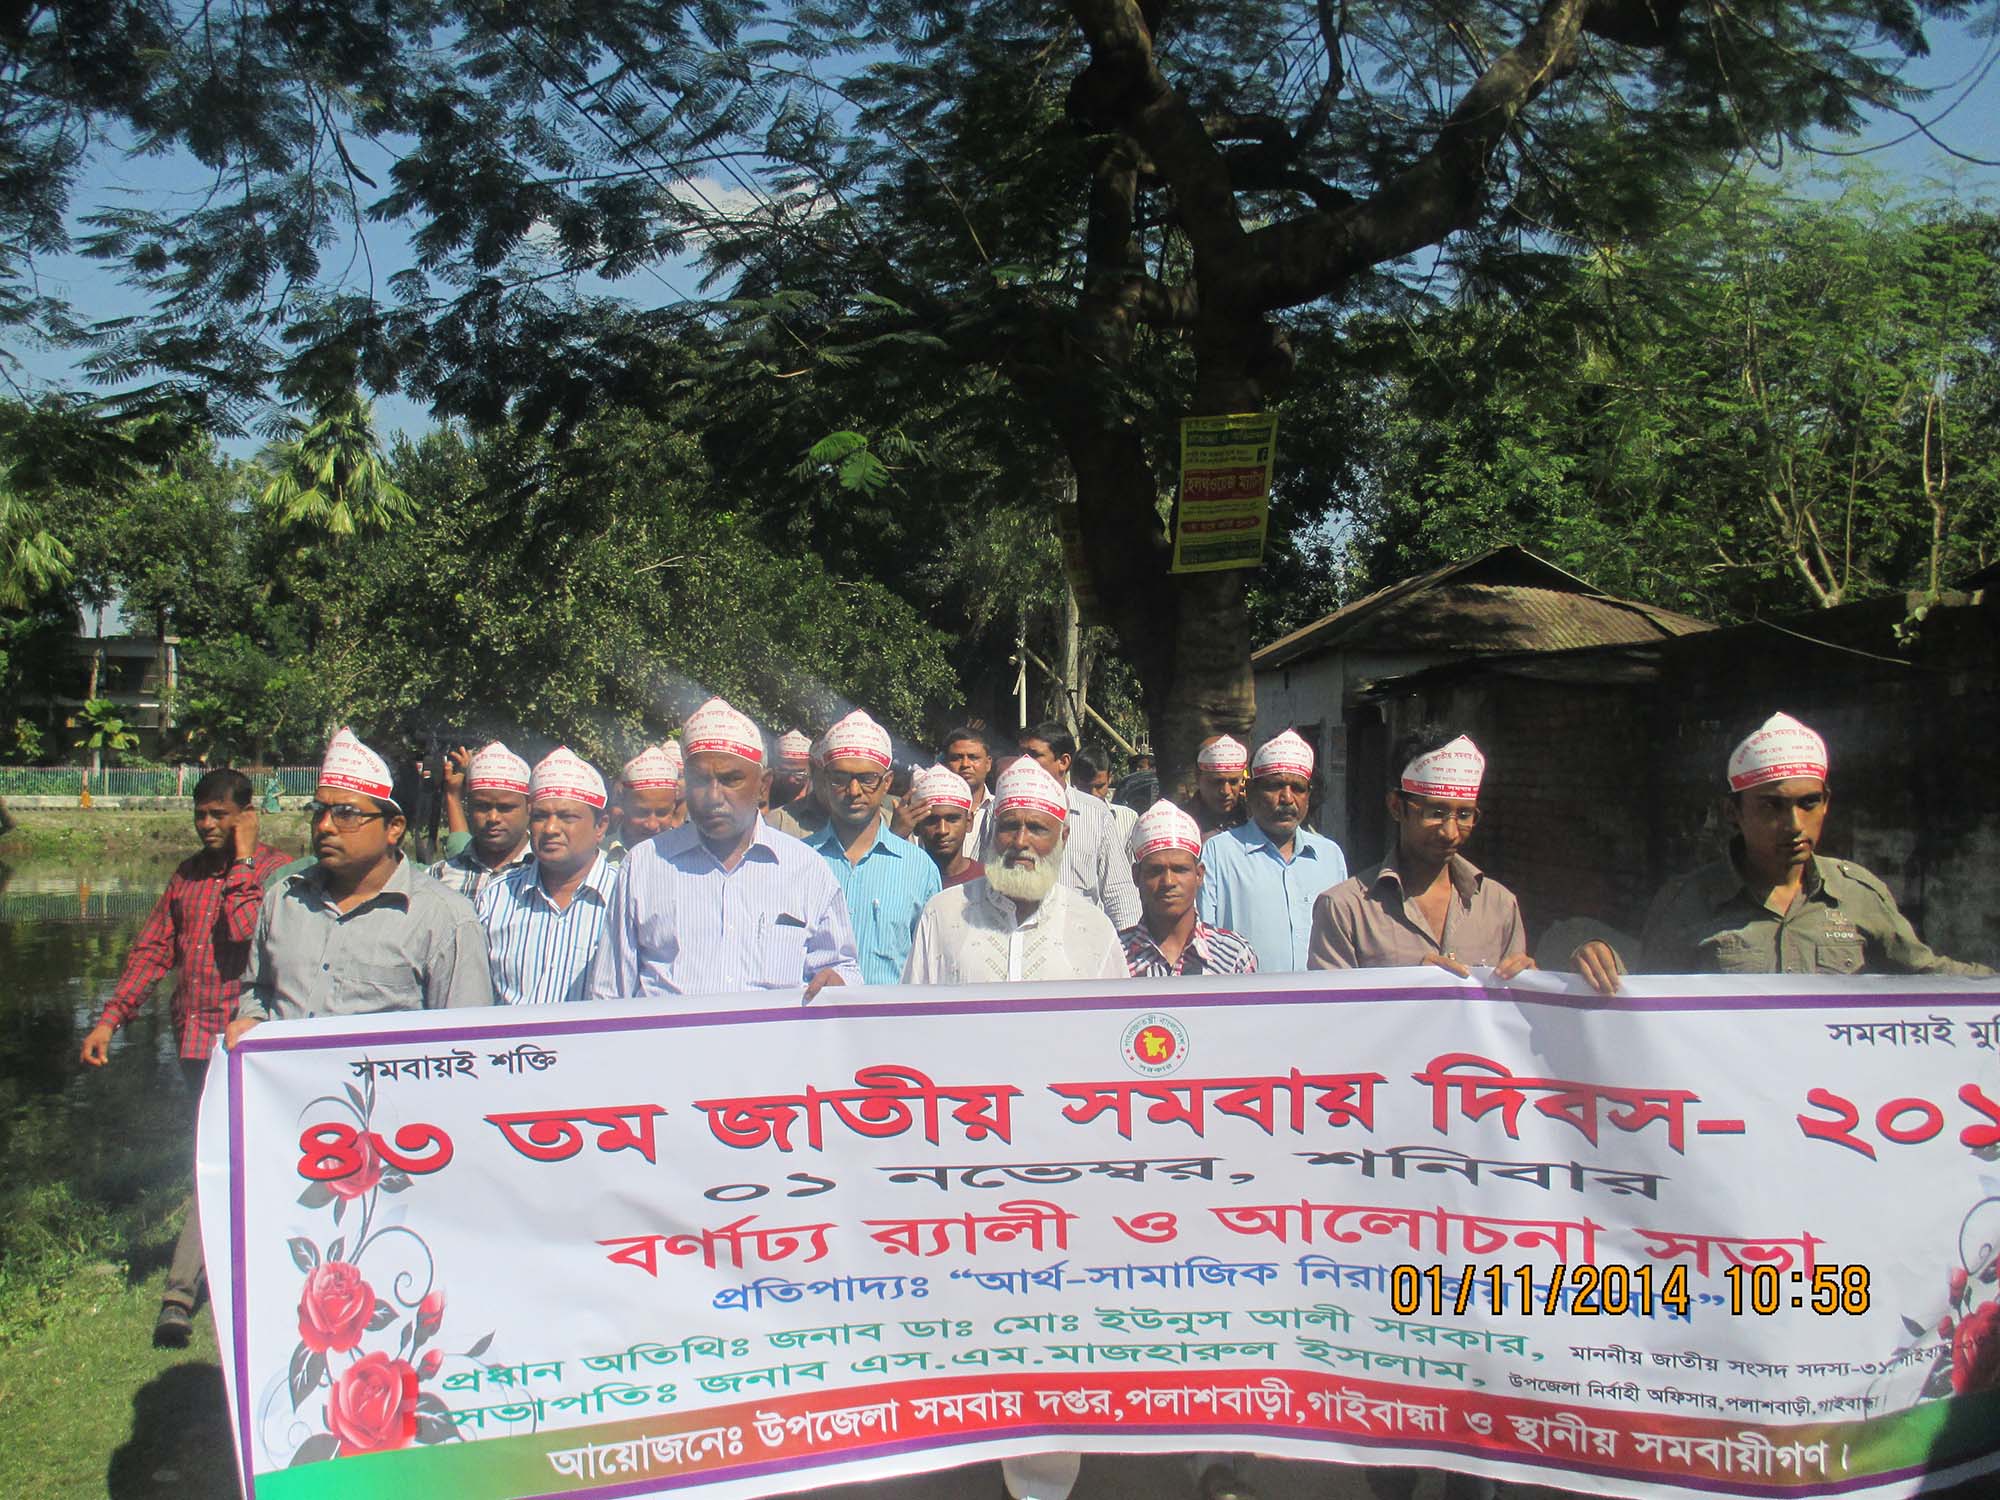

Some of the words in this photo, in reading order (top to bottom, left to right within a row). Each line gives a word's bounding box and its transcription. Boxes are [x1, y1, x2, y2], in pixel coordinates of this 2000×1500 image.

[1825, 1014, 1956, 1047] সমবায়ই
[350, 1049, 475, 1082] সমবায়ই
[489, 1044, 558, 1076] শক্তি
[297, 1121, 454, 1181] ৪৩
[484, 1103, 668, 1164] তম
[692, 1064, 1024, 1154] জাতীয়
[1046, 1068, 1389, 1142] সমবায়
[703, 1172, 837, 1202] ০১
[876, 1157, 1256, 1191] নভেম্বর,
[1292, 1146, 1672, 1200] শনিবার
[595, 1215, 839, 1278] বর্ণাঢ্য
[1113, 1210, 1178, 1244] ও
[1209, 1198, 1606, 1268] আলোচনা
[1635, 1229, 1828, 1284] সভা
[579, 1336, 749, 1373] অতিথিঃ
[764, 1322, 885, 1349] জনাব
[899, 1317, 973, 1339] ডাঃ
[993, 1312, 1080, 1335] মোঃ
[1094, 1306, 1232, 1336] ইউনুস
[1246, 1303, 1355, 1334] আলী
[1569, 1343, 1644, 1366] মাননীয়
[1651, 1350, 1721, 1373] জাতীয়
[1726, 1358, 1789, 1379] সংসদ
[443, 1383, 677, 1429] সভাপতিঃ
[696, 1360, 830, 1394] জনাব
[1296, 1336, 1487, 1388] ইসলাম,
[1508, 1371, 1581, 1395] উপজেলা
[1588, 1379, 1642, 1402] নির্বাহী
[753, 1398, 900, 1449] উপজেলা
[910, 1388, 1025, 1427] সমবায়
[1463, 1411, 1493, 1435] ও
[1505, 1410, 1620, 1457] স্থানীয়
